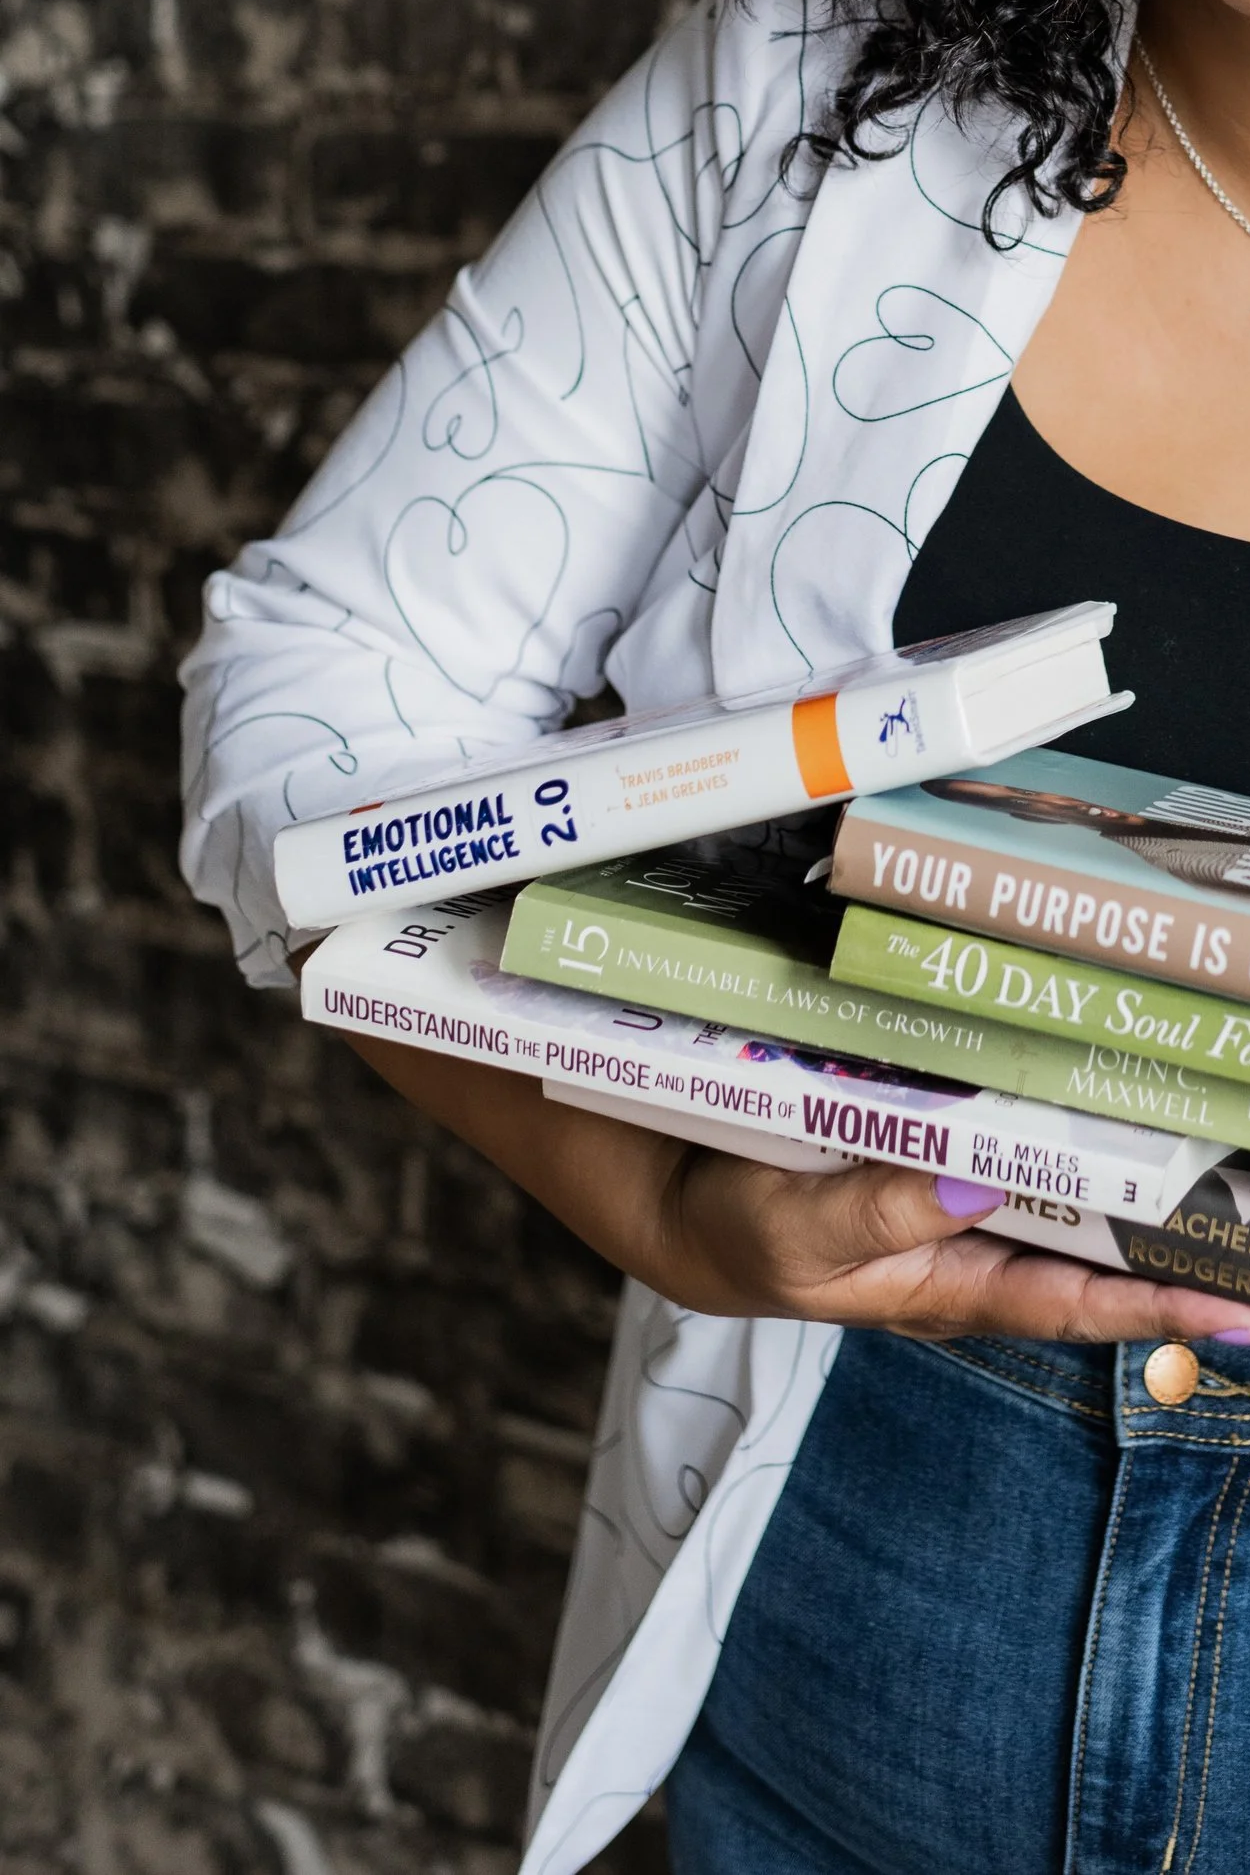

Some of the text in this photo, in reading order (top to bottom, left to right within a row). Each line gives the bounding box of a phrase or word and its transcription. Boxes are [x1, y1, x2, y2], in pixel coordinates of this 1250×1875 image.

[620, 748, 740, 790] TRAVIS BRADBERRY
[638, 787, 668, 808] JEAN
[672, 773, 728, 799] GREAVES
[343, 793, 513, 864] EMOTIONAL
[534, 778, 578, 847] 2.0
[348, 830, 520, 896] INTELLIGENCE
[873, 842, 972, 910] YOUR
[989, 872, 1174, 962] PURPOSE
[1189, 923, 1232, 975] IS
[383, 924, 456, 959] DR.
[541, 926, 556, 952] THE
[558, 919, 609, 976] 15
[616, 948, 984, 1052] INVALUABLE LAWS OF GROWTH
[887, 933, 921, 958] The
[920, 937, 988, 997] 40
[994, 963, 1099, 1024] DAY
[1104, 989, 1201, 1051] Soul
[324, 988, 509, 1056] UNDERSTANDING
[514, 1037, 541, 1059] THE
[545, 1041, 651, 1090] PURPOSE
[654, 1072, 685, 1093] AND
[690, 1077, 772, 1119] POWER
[778, 1100, 797, 1119] OF
[803, 1093, 949, 1167] WOMEN
[1083, 1043, 1169, 1084] JOHN
[1067, 1067, 1214, 1126] MAXWELL
[971, 1152, 1090, 1201] MUNROE
[973, 1133, 1079, 1173] DR. MYLES
